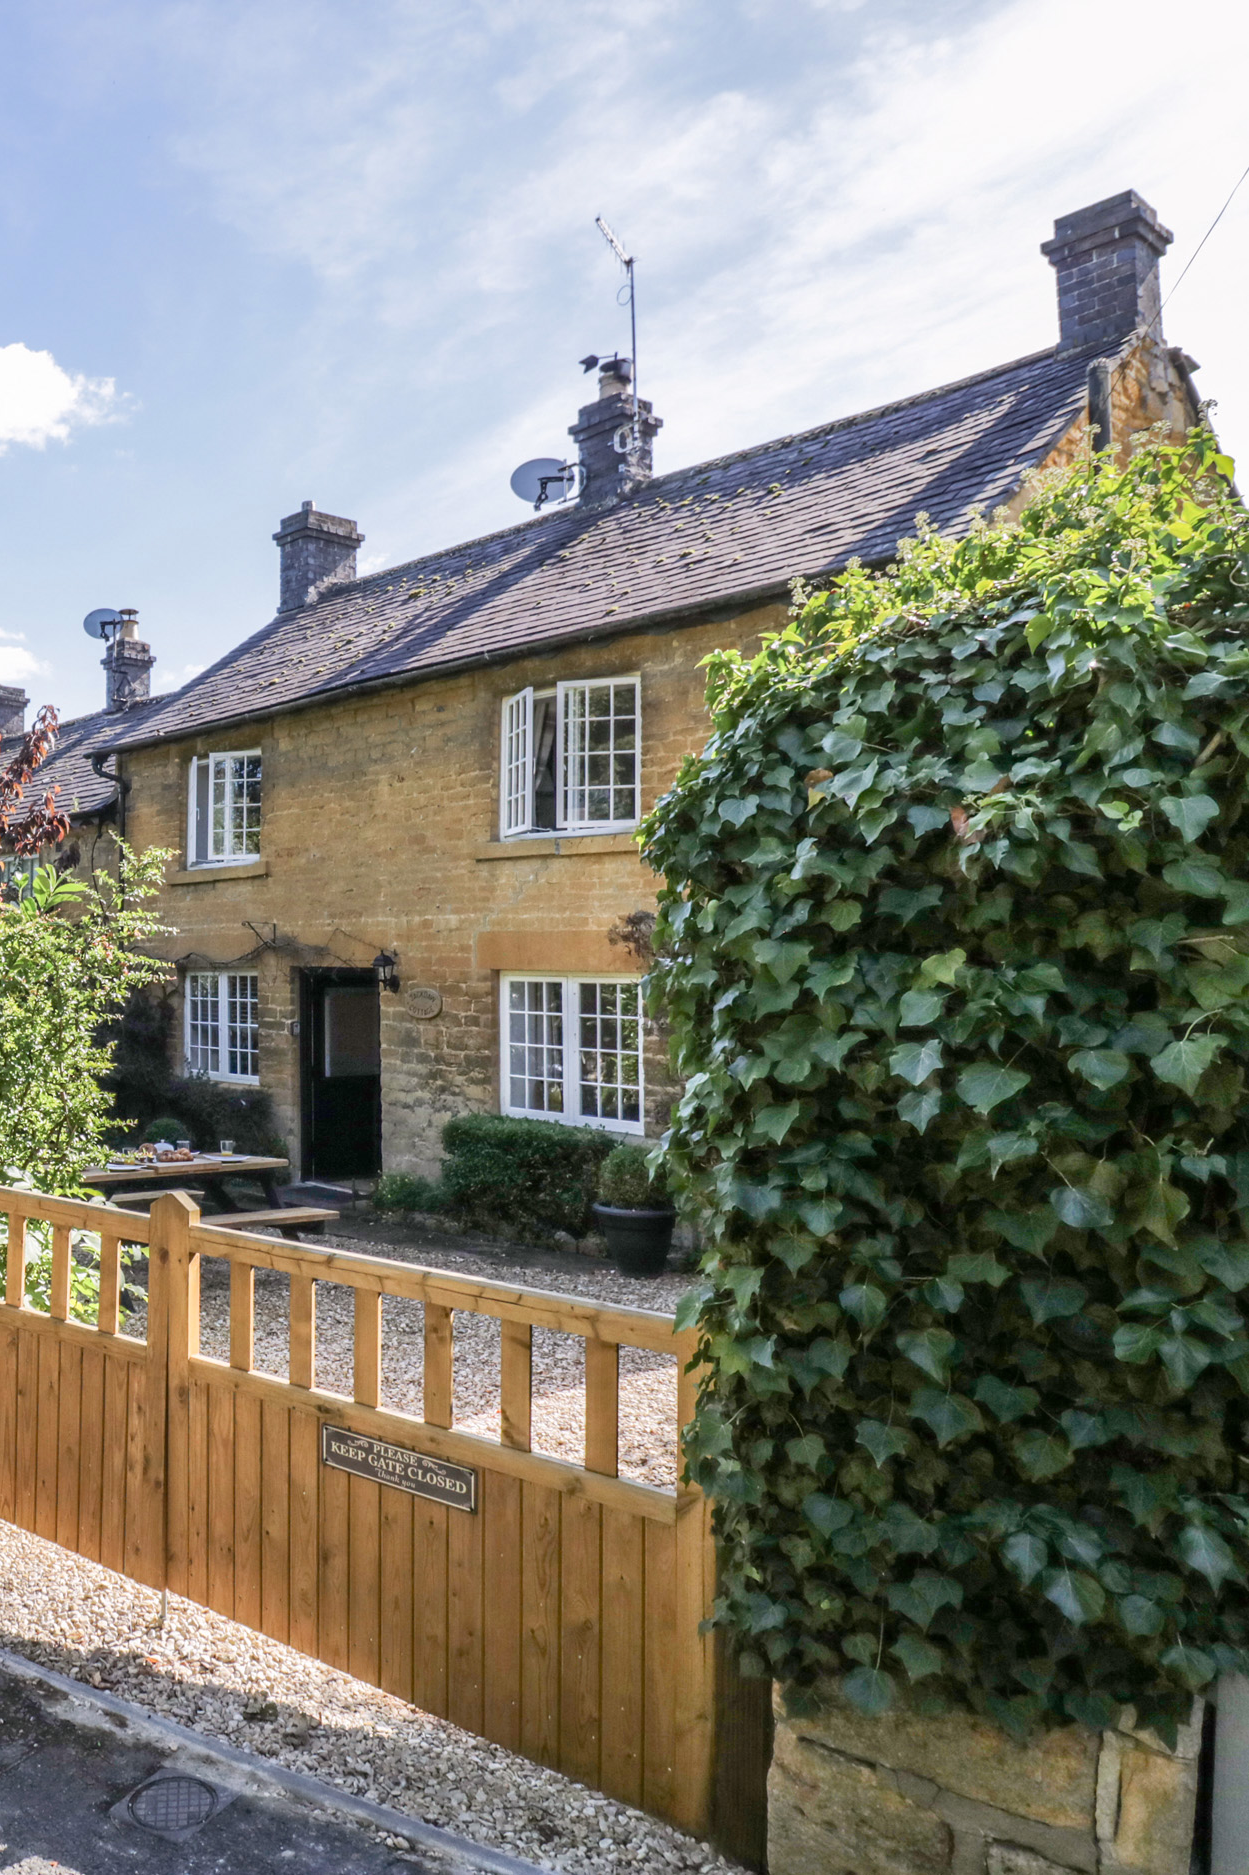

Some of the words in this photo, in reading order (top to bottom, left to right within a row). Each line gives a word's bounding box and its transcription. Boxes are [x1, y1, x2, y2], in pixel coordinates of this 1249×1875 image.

[373, 1443, 418, 1466] PLEASE
[330, 1440, 366, 1462] KEEP
[368, 1455, 405, 1476] GATE
[407, 1467, 467, 1494] CLOSED
[375, 1467, 400, 1484] Thank
[401, 1479, 416, 1489] you
